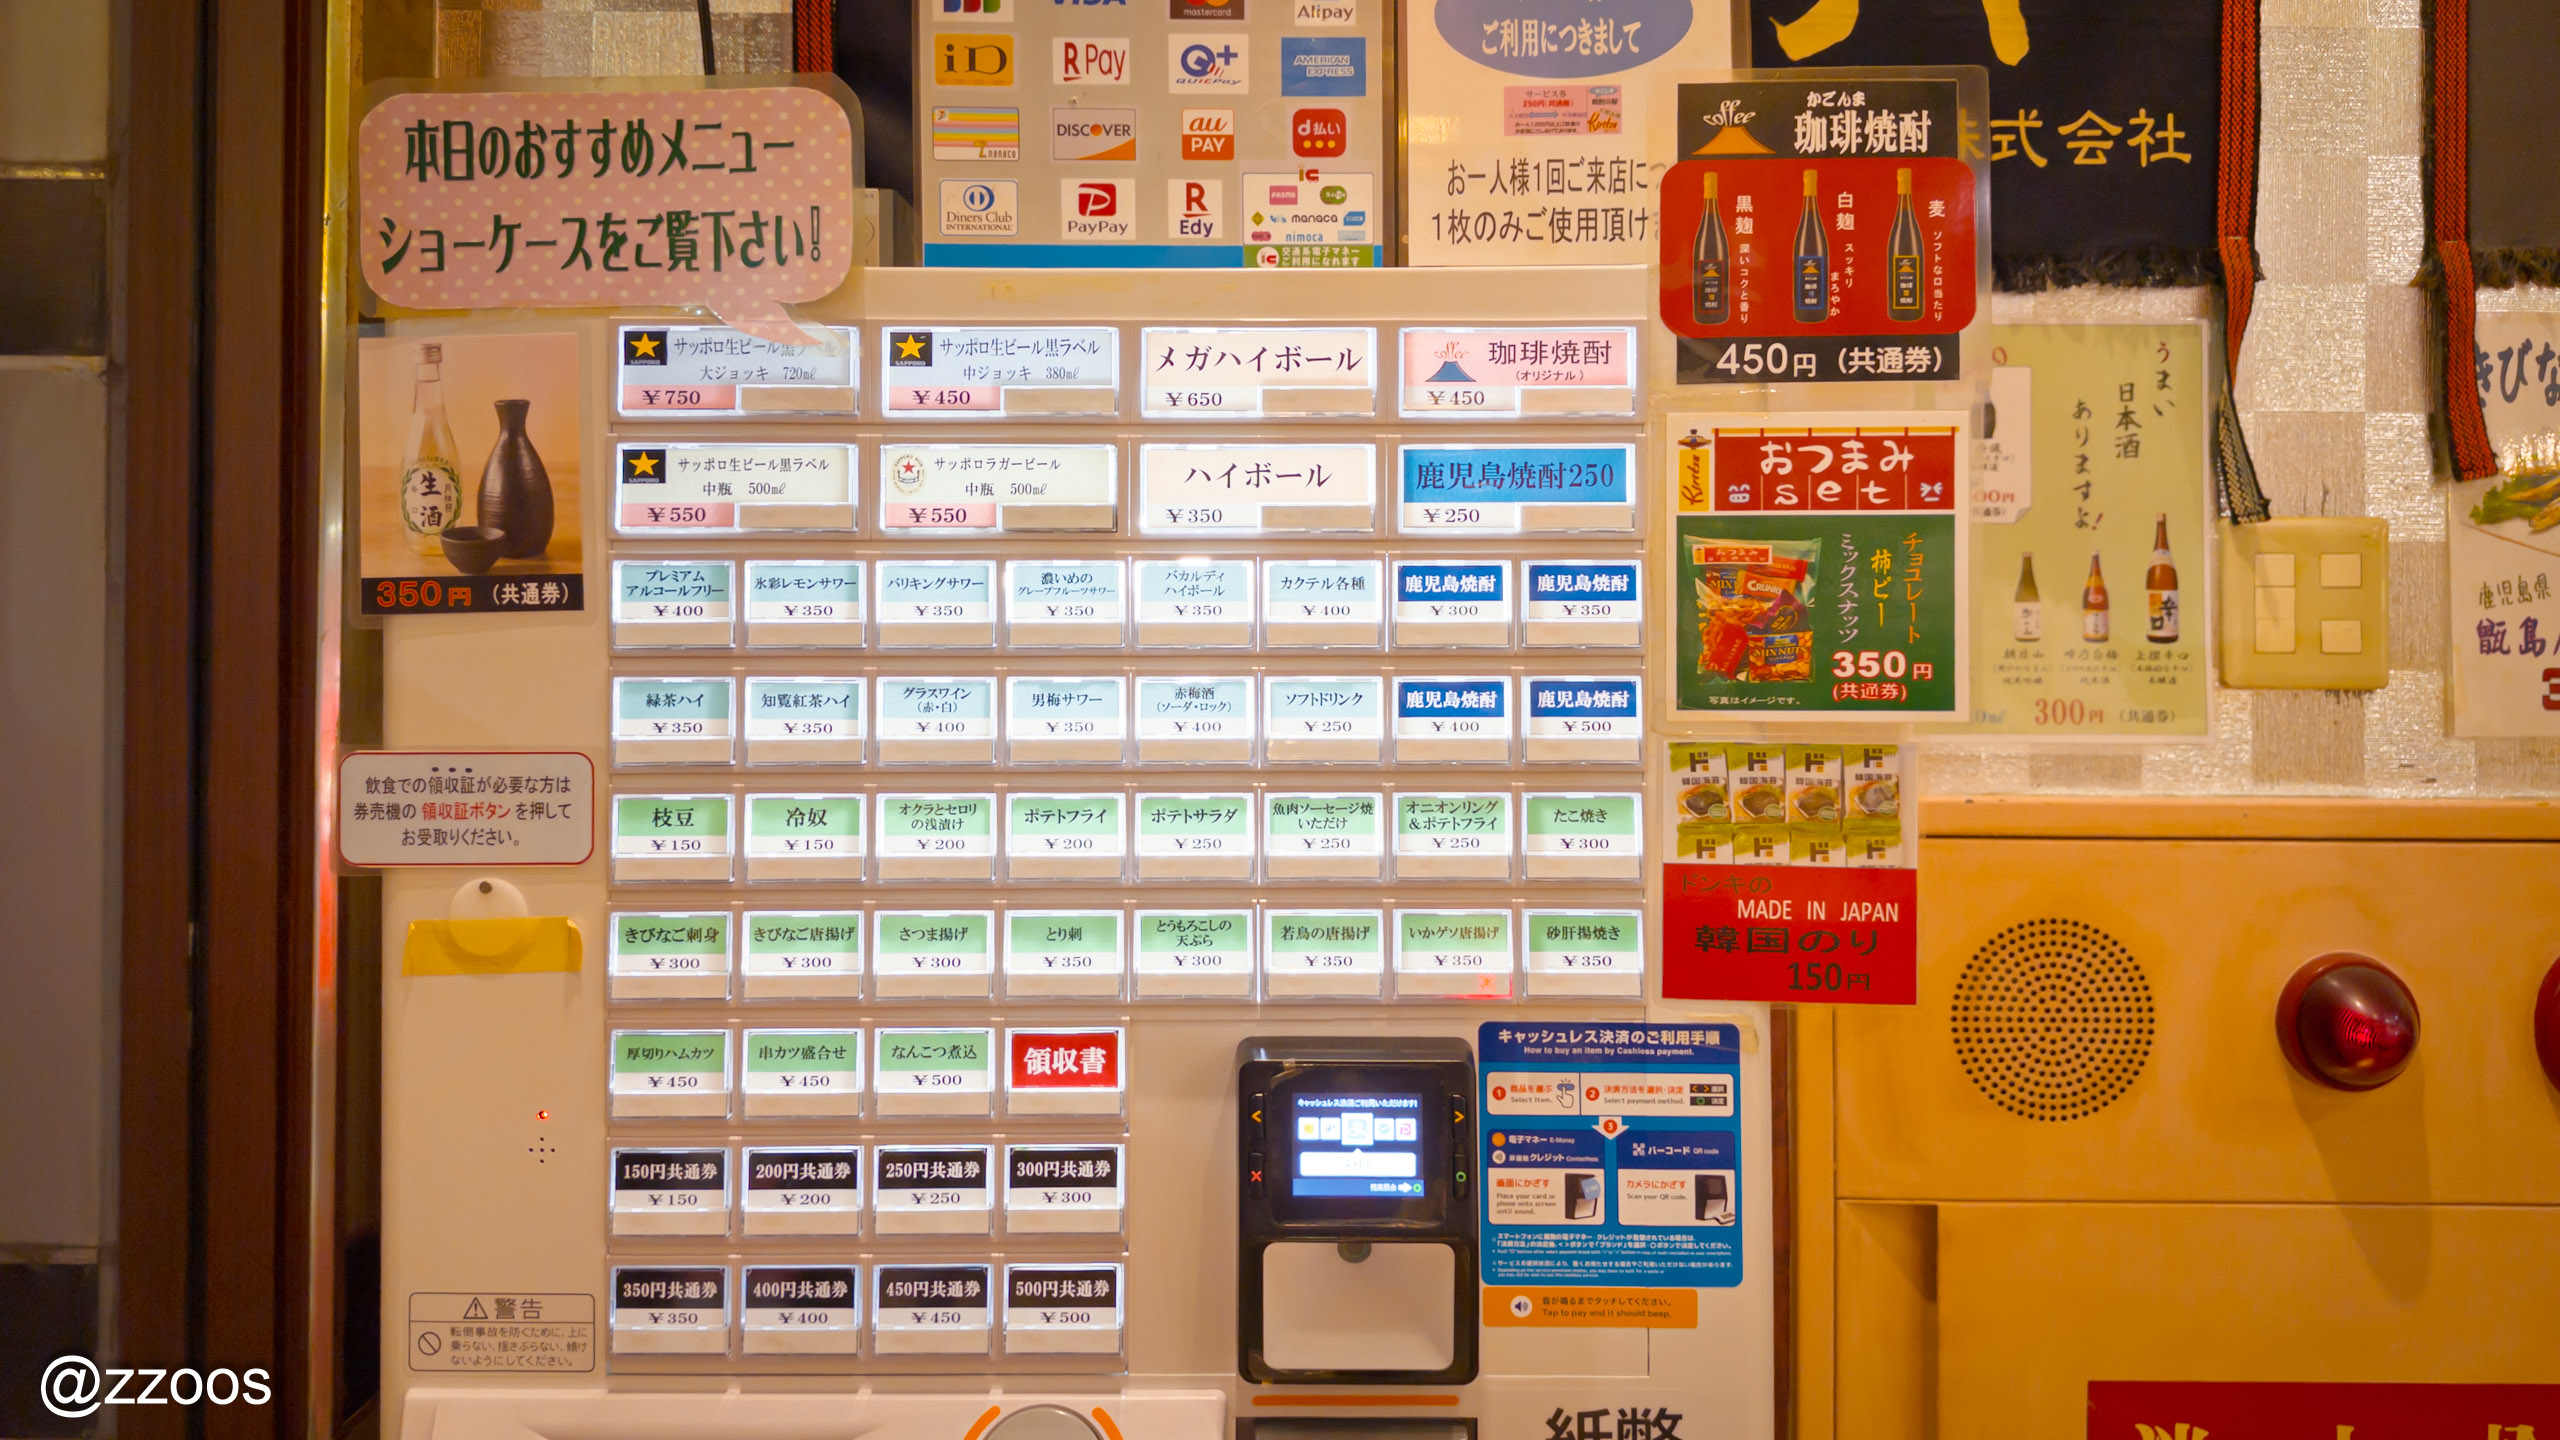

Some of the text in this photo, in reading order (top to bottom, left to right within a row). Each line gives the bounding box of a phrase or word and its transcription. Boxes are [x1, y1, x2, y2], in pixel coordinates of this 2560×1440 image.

[1184, 8, 1231, 16] mastercard
[1298, 5, 1353, 21] Alipay
[1482, 19, 1642, 57] ご利用につきまして
[944, 44, 1007, 74] iD
[1294, 55, 1350, 65] AMERICAN
[1306, 67, 1354, 77] EXPRESS
[1057, 123, 1132, 137] DISCOVER
[1189, 117, 1229, 132] au
[1298, 119, 1341, 136] d払い
[1794, 110, 1932, 154] 珈琲焼酎
[405, 118, 795, 183] 本日のおすすめメニュー
[1192, 138, 1225, 152] PAY
[1736, 196, 1753, 234] 黒麹
[1837, 192, 1855, 230] 白麹
[1929, 201, 1945, 217] 麦
[947, 212, 1013, 223] Diners Club
[1292, 215, 1338, 223] manaca
[1068, 220, 1128, 235] PayPay
[1180, 219, 1212, 237] Edy
[379, 205, 821, 274] ショーケースをご覧下さい!
[1286, 231, 1323, 242] nimoca
[1830, 271, 1840, 316] まろやか
[940, 338, 1100, 357] サッポロ生ビール黒ラベル
[1489, 340, 1612, 365] 珈琲焼酎
[1156, 345, 1363, 372] メガハイボール
[1716, 343, 1816, 377] 450円
[701, 367, 769, 381] 大ジョッキ
[963, 366, 1031, 380] 中ジョッキ
[2153, 341, 2174, 417] うまい
[2115, 382, 2141, 458] 日本酒
[679, 458, 829, 472] サッポロ生ビール黒ラベル
[934, 457, 1061, 470] サッポロラガービール
[1760, 440, 1914, 474] おつまみ
[1184, 463, 1332, 488] ハイボール
[1417, 462, 1613, 489] 鹿児島焼酎250
[703, 482, 732, 495] 中瓶
[966, 483, 994, 496] 中瓶
[420, 471, 442, 527] 生酒
[646, 570, 705, 582] プレミアム
[754, 578, 856, 590] 氷彩レモンサワー
[888, 578, 984, 589] バリキングサワー
[1041, 572, 1092, 585] 濃いめの
[1165, 570, 1225, 582] バカルディ
[1281, 577, 1365, 590] カクテル各種
[1405, 575, 1496, 593] 鹿児島焼酎
[1537, 575, 1629, 592] 鹿児島焼酎
[377, 580, 472, 606] 350円
[627, 585, 724, 597] アルコールフリー
[1017, 587, 1115, 595] グレープフルーツサワー
[1164, 585, 1225, 596] ハイボール
[1837, 534, 1859, 644] ミックスナッツ
[1871, 549, 1892, 628] 柿ピー
[1902, 532, 1923, 644] チョコレート
[2480, 573, 2551, 609] 鹿児島県
[1832, 650, 1933, 680] 350円
[903, 688, 972, 700] グラスワイン
[1032, 693, 1103, 707] 男梅サワー
[1175, 687, 1215, 699] 赤梅酒
[1286, 693, 1363, 707] ソフトドリンク
[1407, 691, 1497, 709] 鹿児島焼酎
[1537, 690, 1629, 708] 鹿児島焼酎
[1832, 683, 1907, 701] (共通券)
[646, 694, 704, 708] 緑茶ハイ
[762, 694, 850, 708] 知覧紅茶ハイ
[1709, 696, 1800, 705] 写真はイメージです。
[2035, 698, 2103, 725] 300円
[365, 776, 571, 794] 飲食での領収証が必要な方は
[354, 802, 572, 820] 券売機の 領収証ボタン を押して
[900, 804, 976, 815] オクラとセロリ
[1273, 803, 1373, 815] 魚肉ソーセージ焼
[1406, 800, 1498, 814] オニオンリング
[652, 808, 695, 827] 枝豆
[786, 808, 828, 827] 冷奴
[1025, 809, 1107, 824] ポテトフライ
[1151, 808, 1238, 823] ポテトサラダ
[1298, 817, 1348, 829] いただけ
[1554, 808, 1607, 823] たこ焼き
[911, 818, 964, 831] の浅漬け
[402, 829, 519, 846] お受取りください。
[1682, 874, 1772, 894] ドンキの
[1738, 900, 1898, 922] MADE IN JAPAN
[1046, 927, 1082, 941] とり刺
[1157, 920, 1232, 932] とうもろこしの
[1281, 926, 1370, 941] 若鳥の唐揚げ
[1409, 926, 1499, 939] いかゲソ唐揚げ
[1546, 926, 1620, 941] 砂肝揚焼き
[625, 927, 719, 943] きびなご刺身
[754, 927, 855, 942] きびなご唐揚げ
[900, 927, 968, 942] さつま揚げ
[1177, 935, 1213, 947] 天ぷら
[1695, 925, 1877, 955] 韓国のり
[1788, 962, 1870, 991] 150円
[1499, 1029, 1720, 1045] キャッシュレス決済のご利用手順
[627, 1047, 714, 1060] 厚切りハムカツ
[760, 1046, 846, 1060] 串カツ盛合せ
[891, 1045, 976, 1059] なんこつ煮込
[1555, 1047, 1569, 1055] buy
[1605, 1047, 1614, 1056] by
[1617, 1047, 1655, 1055] Cashless
[1024, 1047, 1106, 1075] 領収書
[1648, 1146, 1690, 1155] バーコード
[624, 1163, 717, 1180] 150円共通券
[756, 1162, 851, 1179] 200円共通券
[886, 1162, 980, 1178] 250円共通券
[1017, 1161, 1110, 1177] 300円共通券
[1627, 1181, 1686, 1189] カメラにかざす
[623, 1281, 718, 1300] 350円共通券
[753, 1281, 848, 1299] 400円共通券
[886, 1281, 981, 1298] 450円共通券
[1015, 1280, 1109, 1298] 500円共通券
[494, 1298, 543, 1319] 警告
